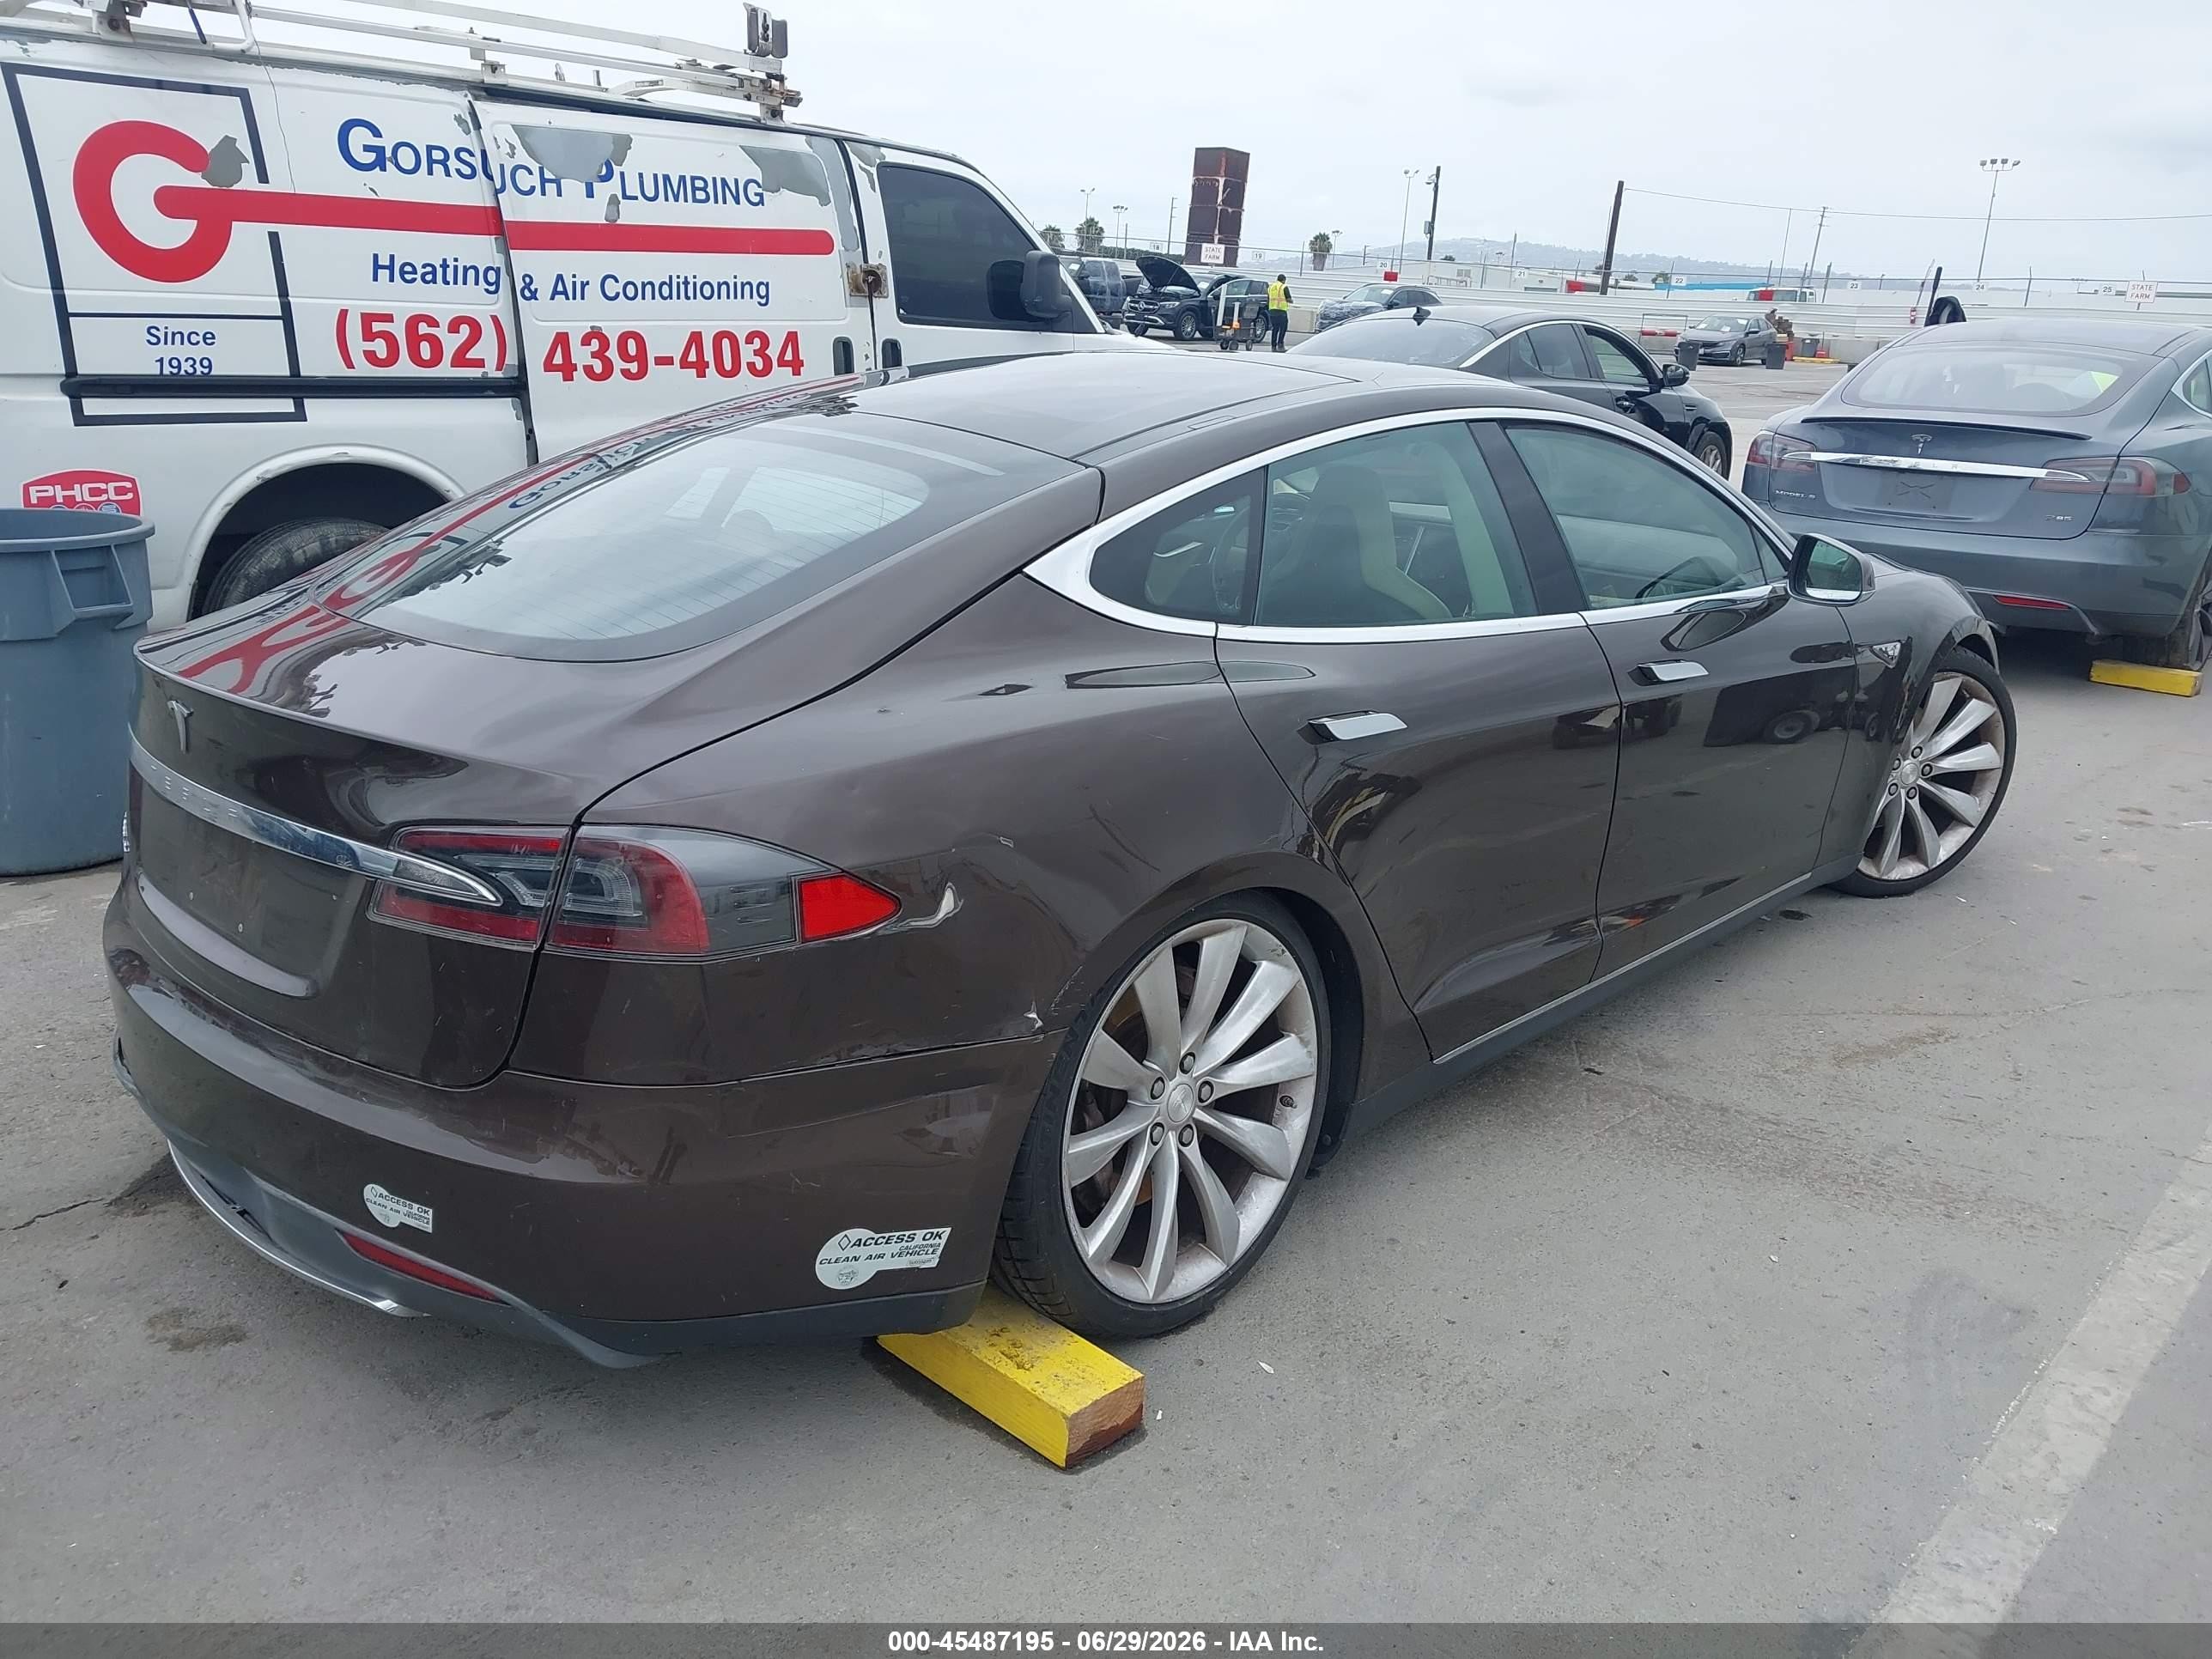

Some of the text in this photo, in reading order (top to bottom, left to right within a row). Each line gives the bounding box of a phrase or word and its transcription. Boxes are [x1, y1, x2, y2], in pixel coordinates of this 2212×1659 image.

[337, 118, 563, 198] GORSUCH
[371, 252, 770, 307] Heating & Air Conditioning
[146, 325, 216, 346] Since
[336, 309, 805, 382] (562) 439-4034
[155, 356, 213, 376] 1939
[28, 481, 134, 504] PHCC
[366, 1197, 430, 1225] CLEAN AIR VEHICLE
[378, 1192, 430, 1216] ACCESS OK
[850, 1231, 947, 1249] ACCESS OK
[898, 1242, 941, 1251] CALIFORNIA
[818, 1248, 939, 1266] CLEAN AIR VEHICLE
